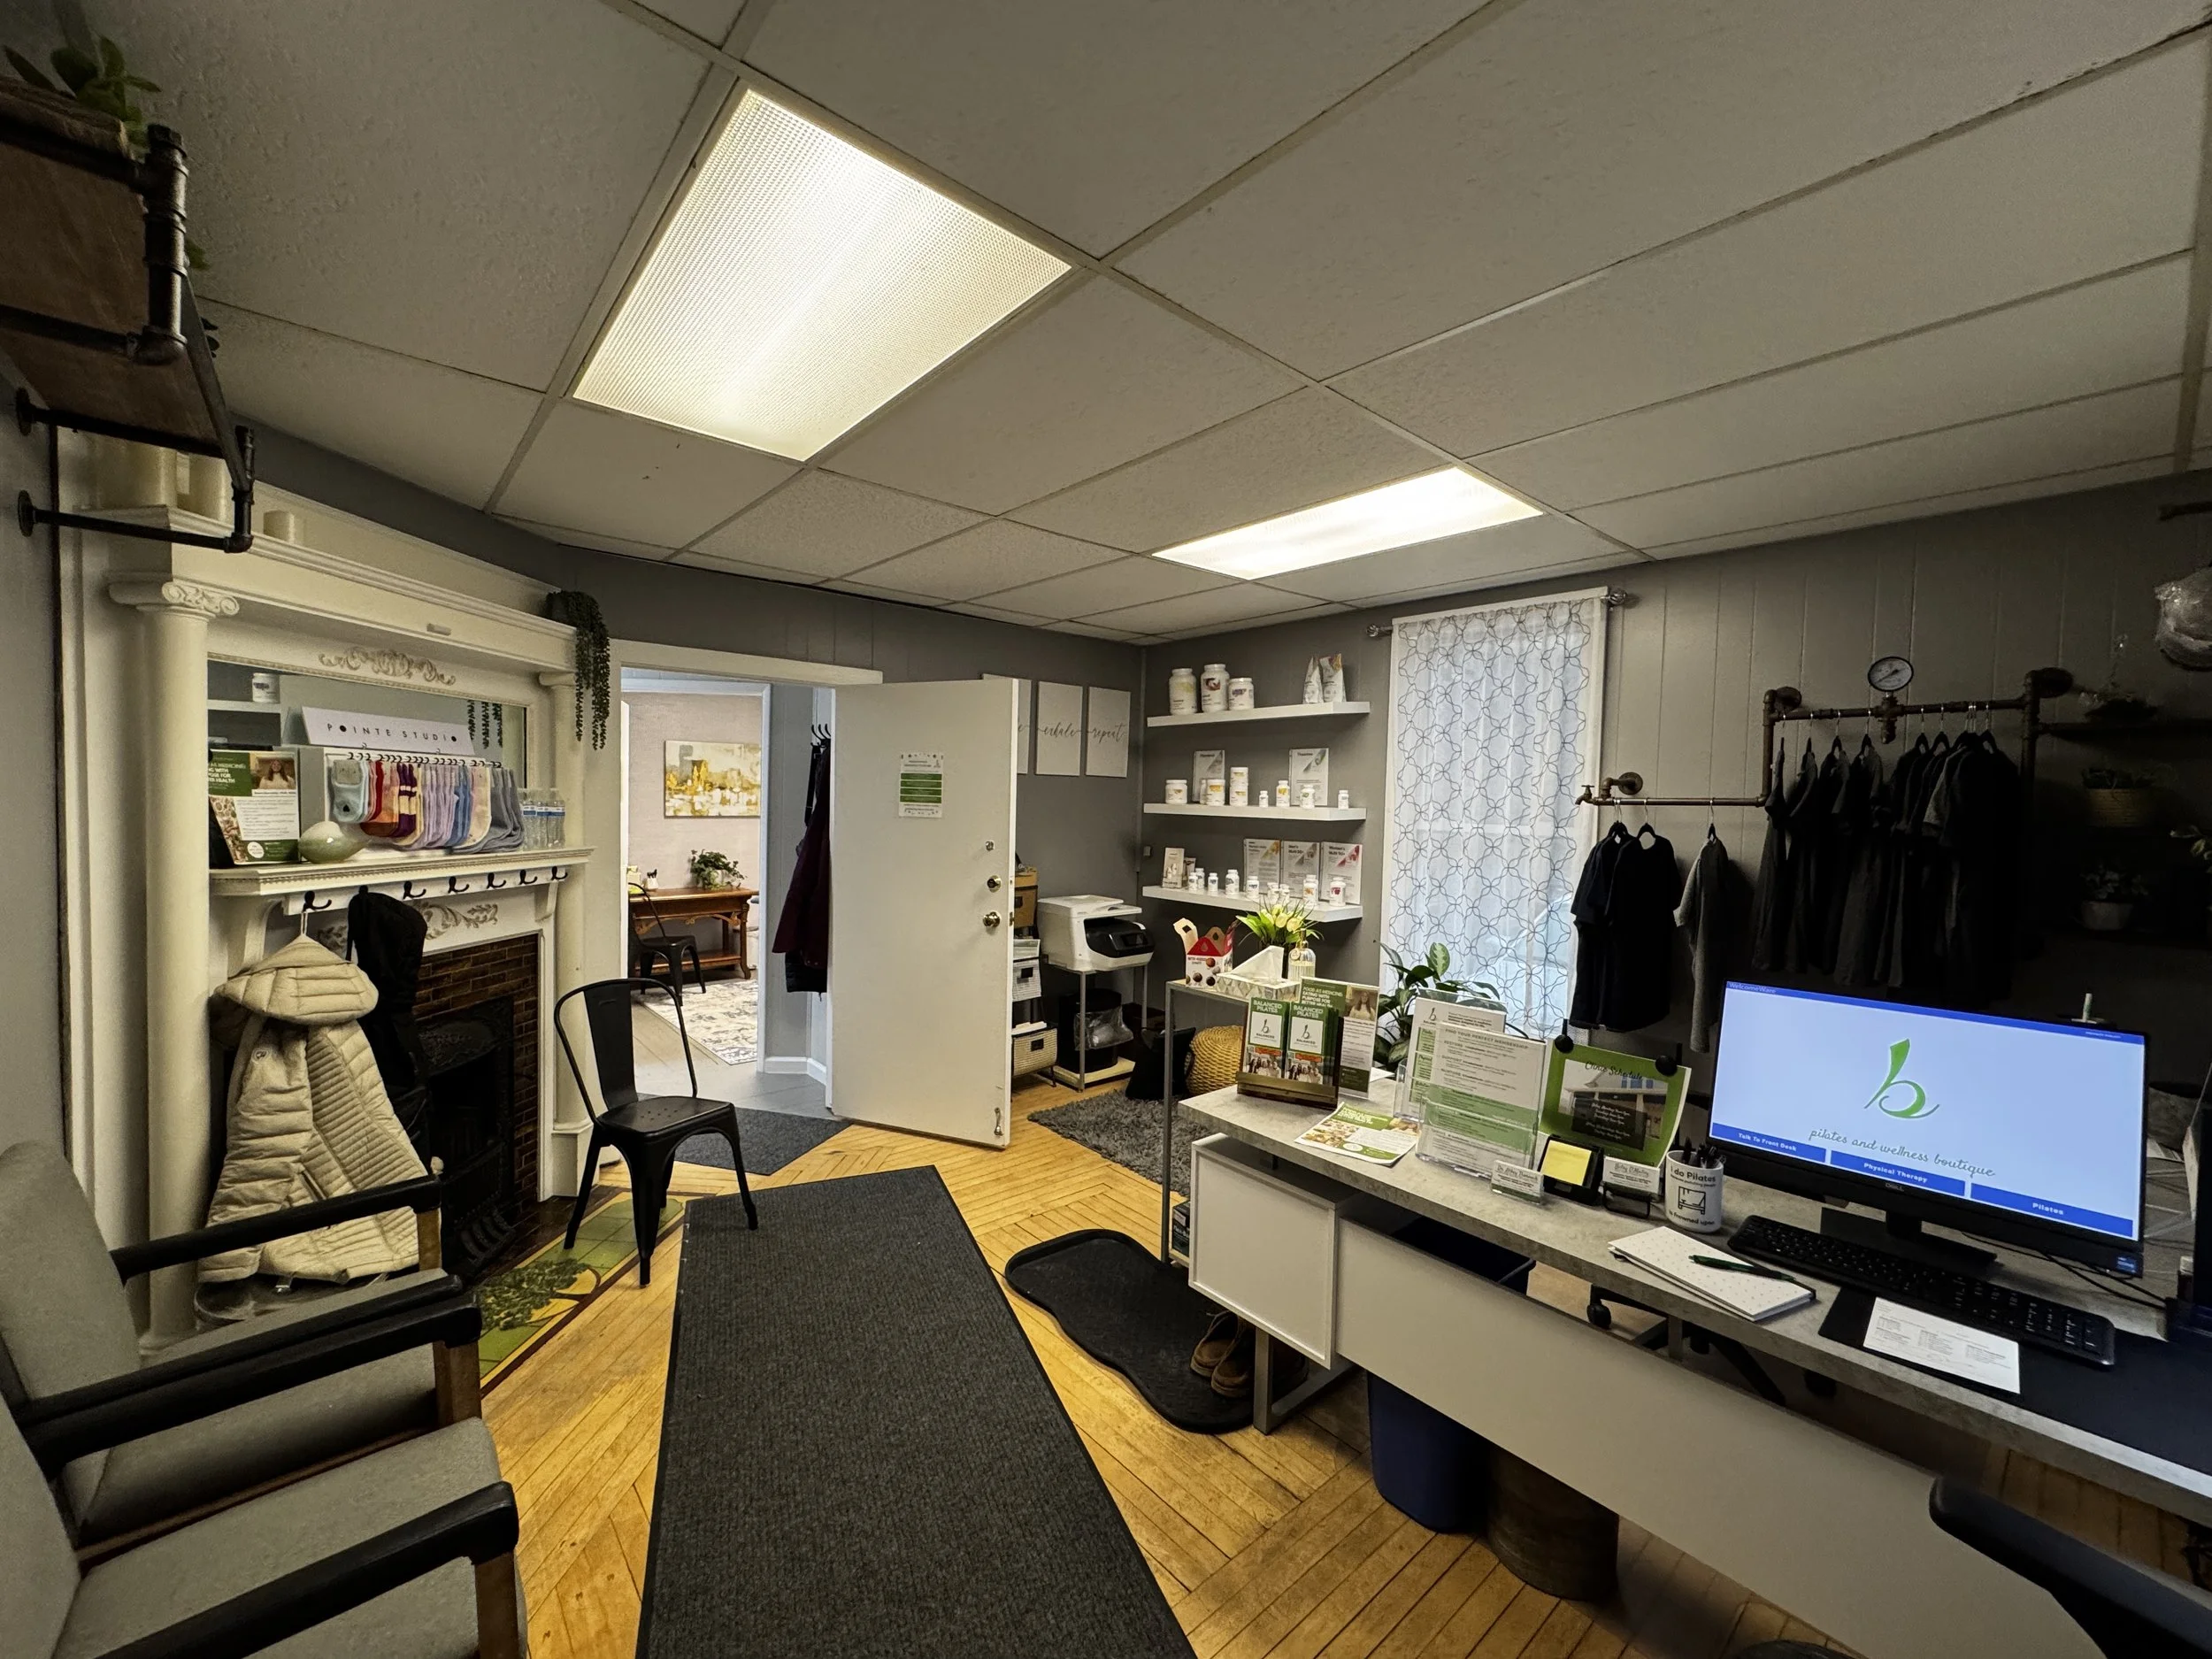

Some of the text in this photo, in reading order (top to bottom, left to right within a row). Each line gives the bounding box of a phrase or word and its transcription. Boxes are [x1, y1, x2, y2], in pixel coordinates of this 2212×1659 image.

[326, 723, 457, 741] POINTE STUDIO
[1039, 722, 1079, 738] exhale
[1090, 724, 1127, 743] repeat
[1729, 982, 1777, 994] WelcomeWare
[1253, 1000, 1283, 1010] BALANCED
[1256, 1005, 1279, 1014] PILATES
[1293, 1004, 1324, 1014] BALANCED
[1585, 1062, 1643, 1079] Clinic Schedule
[1762, 1138, 1779, 1148] Front
[1780, 1142, 1796, 1152] Desk
[1809, 1128, 1995, 1179] pilates and wellness boutique
[1674, 1168, 1685, 1177] do
[1686, 1171, 1717, 1182] Pilates
[1863, 1162, 1928, 1184] Physical Therapy
[2032, 1202, 2064, 1216] Pilates
[1674, 1211, 1699, 1225] frowned
